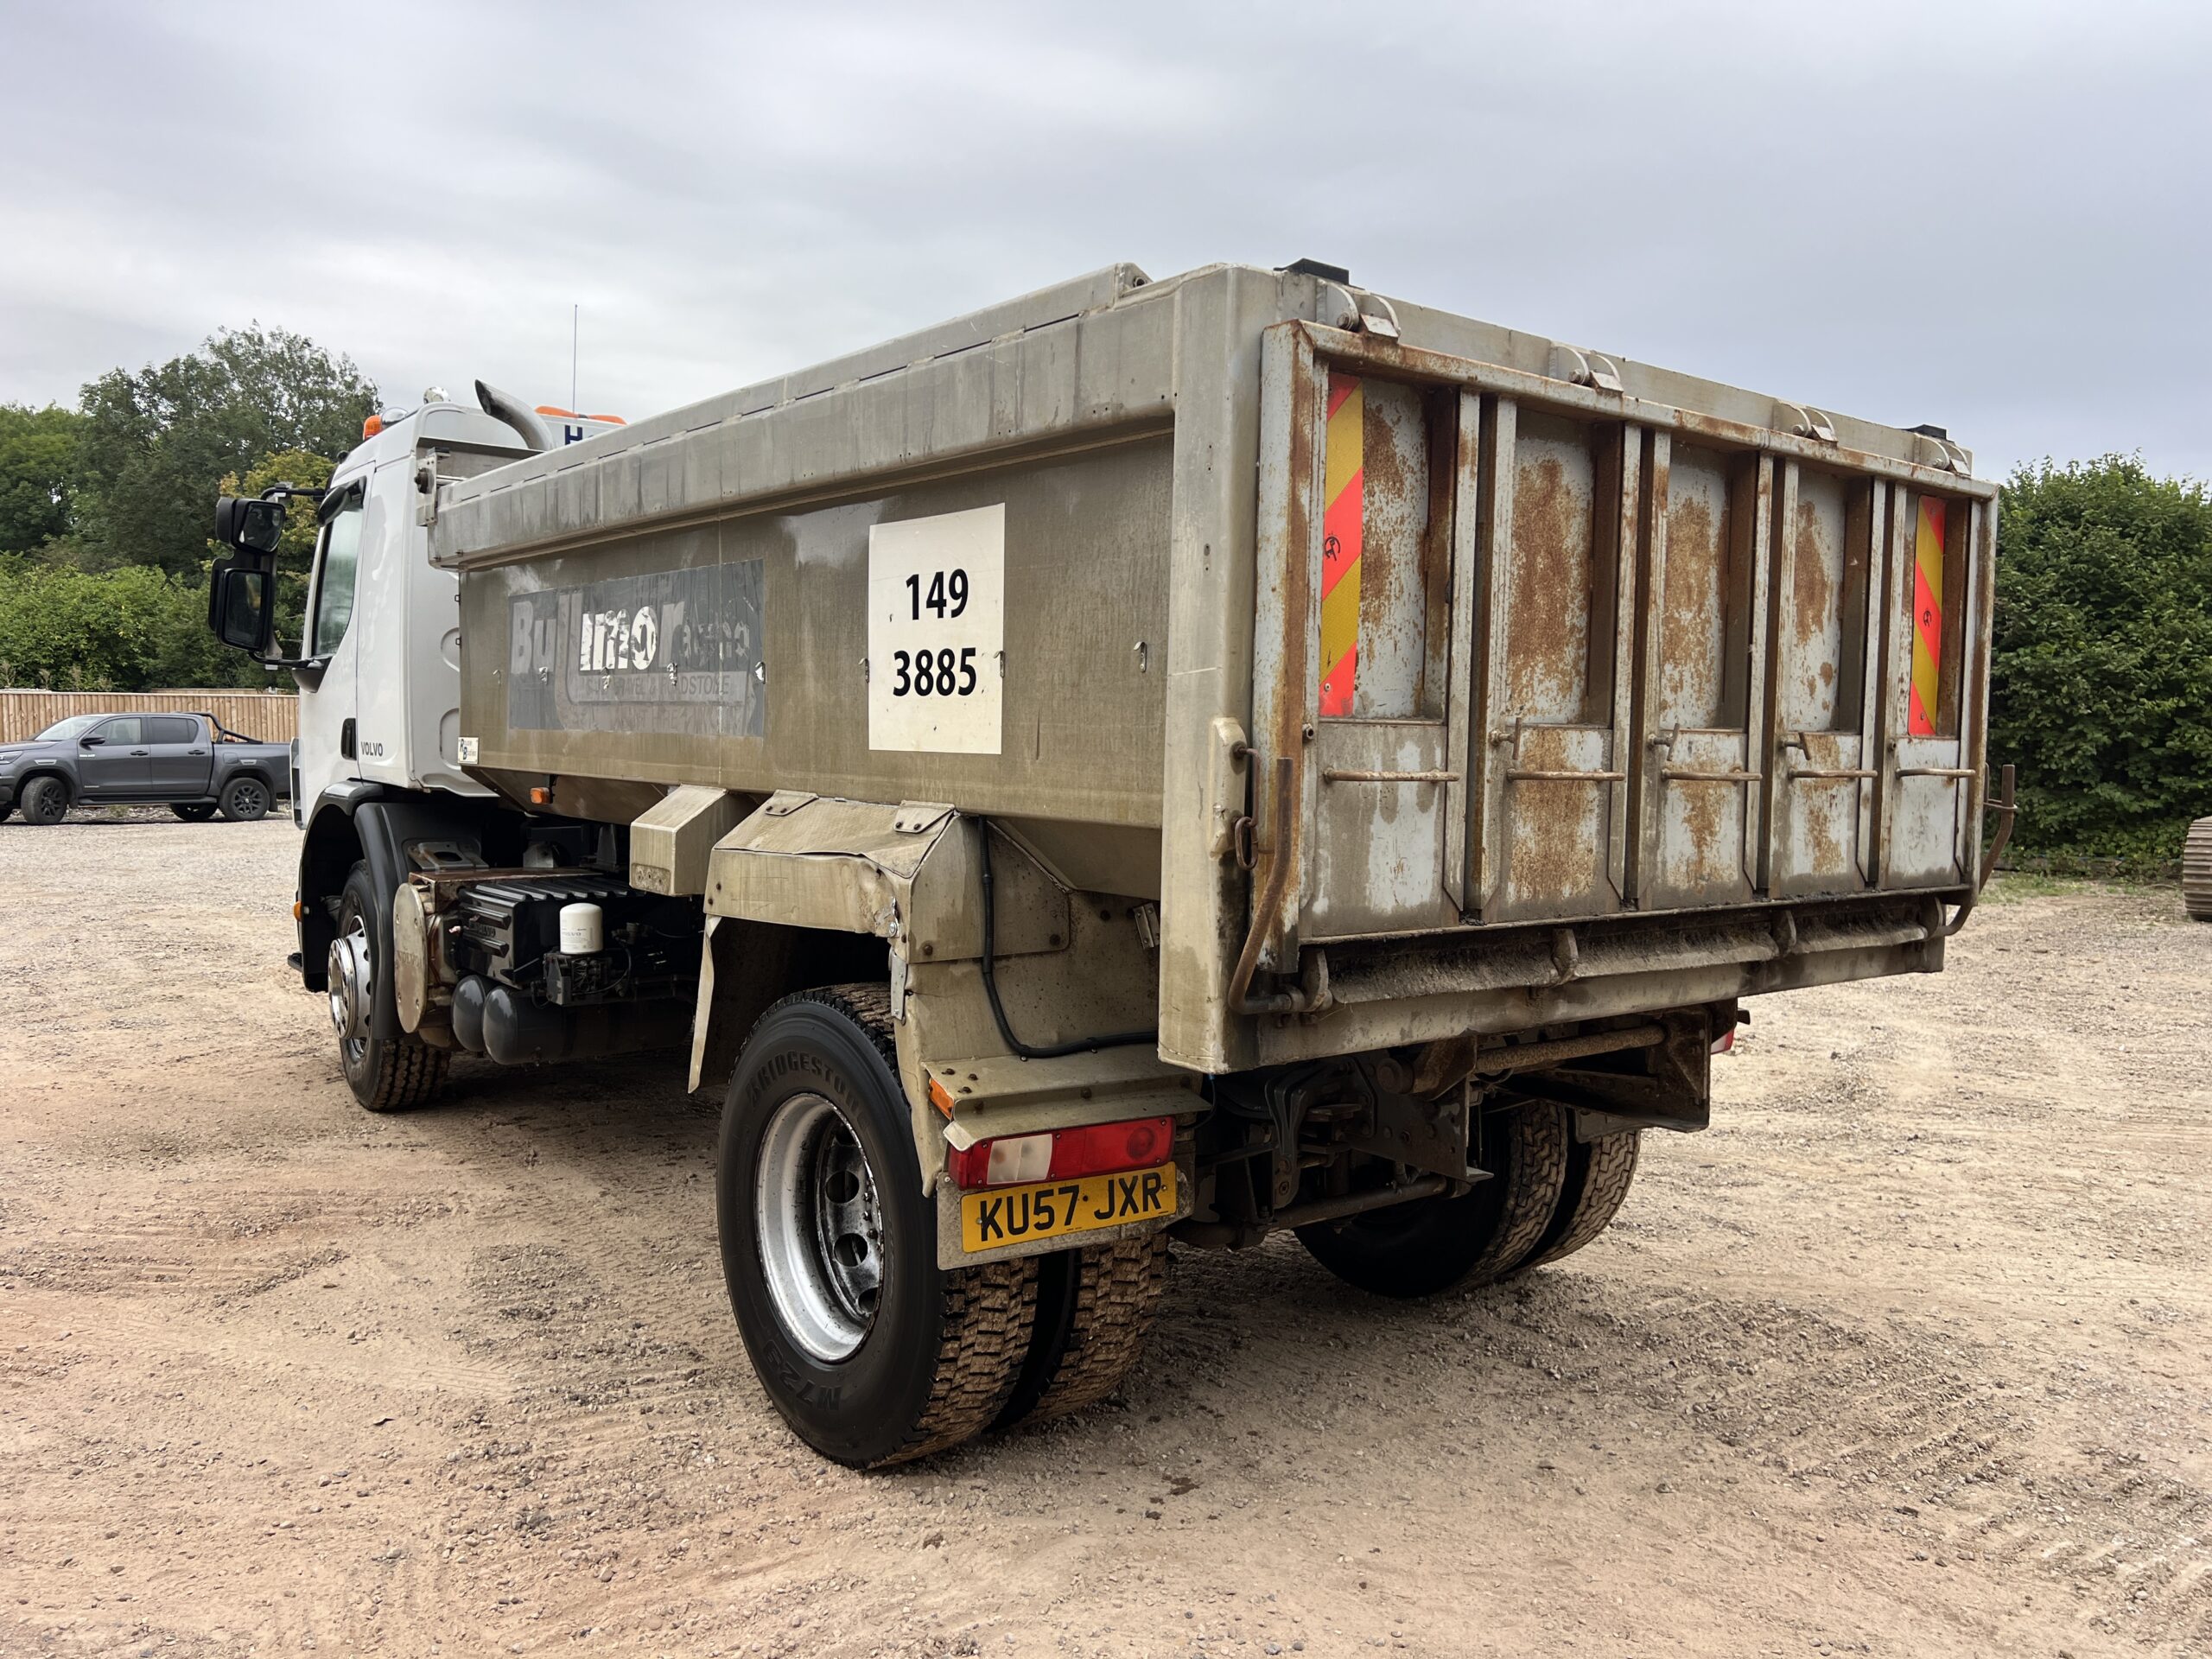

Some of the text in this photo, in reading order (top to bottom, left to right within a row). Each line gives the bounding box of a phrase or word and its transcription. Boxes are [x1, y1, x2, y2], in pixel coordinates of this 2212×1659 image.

[906, 569, 969, 620] 149
[893, 647, 976, 696] 3885
[360, 741, 384, 757] VOLVO
[397, 950, 423, 968] VOLVO
[979, 1172, 1161, 1242] KU57 JXR
[762, 1339, 843, 1411] M723
